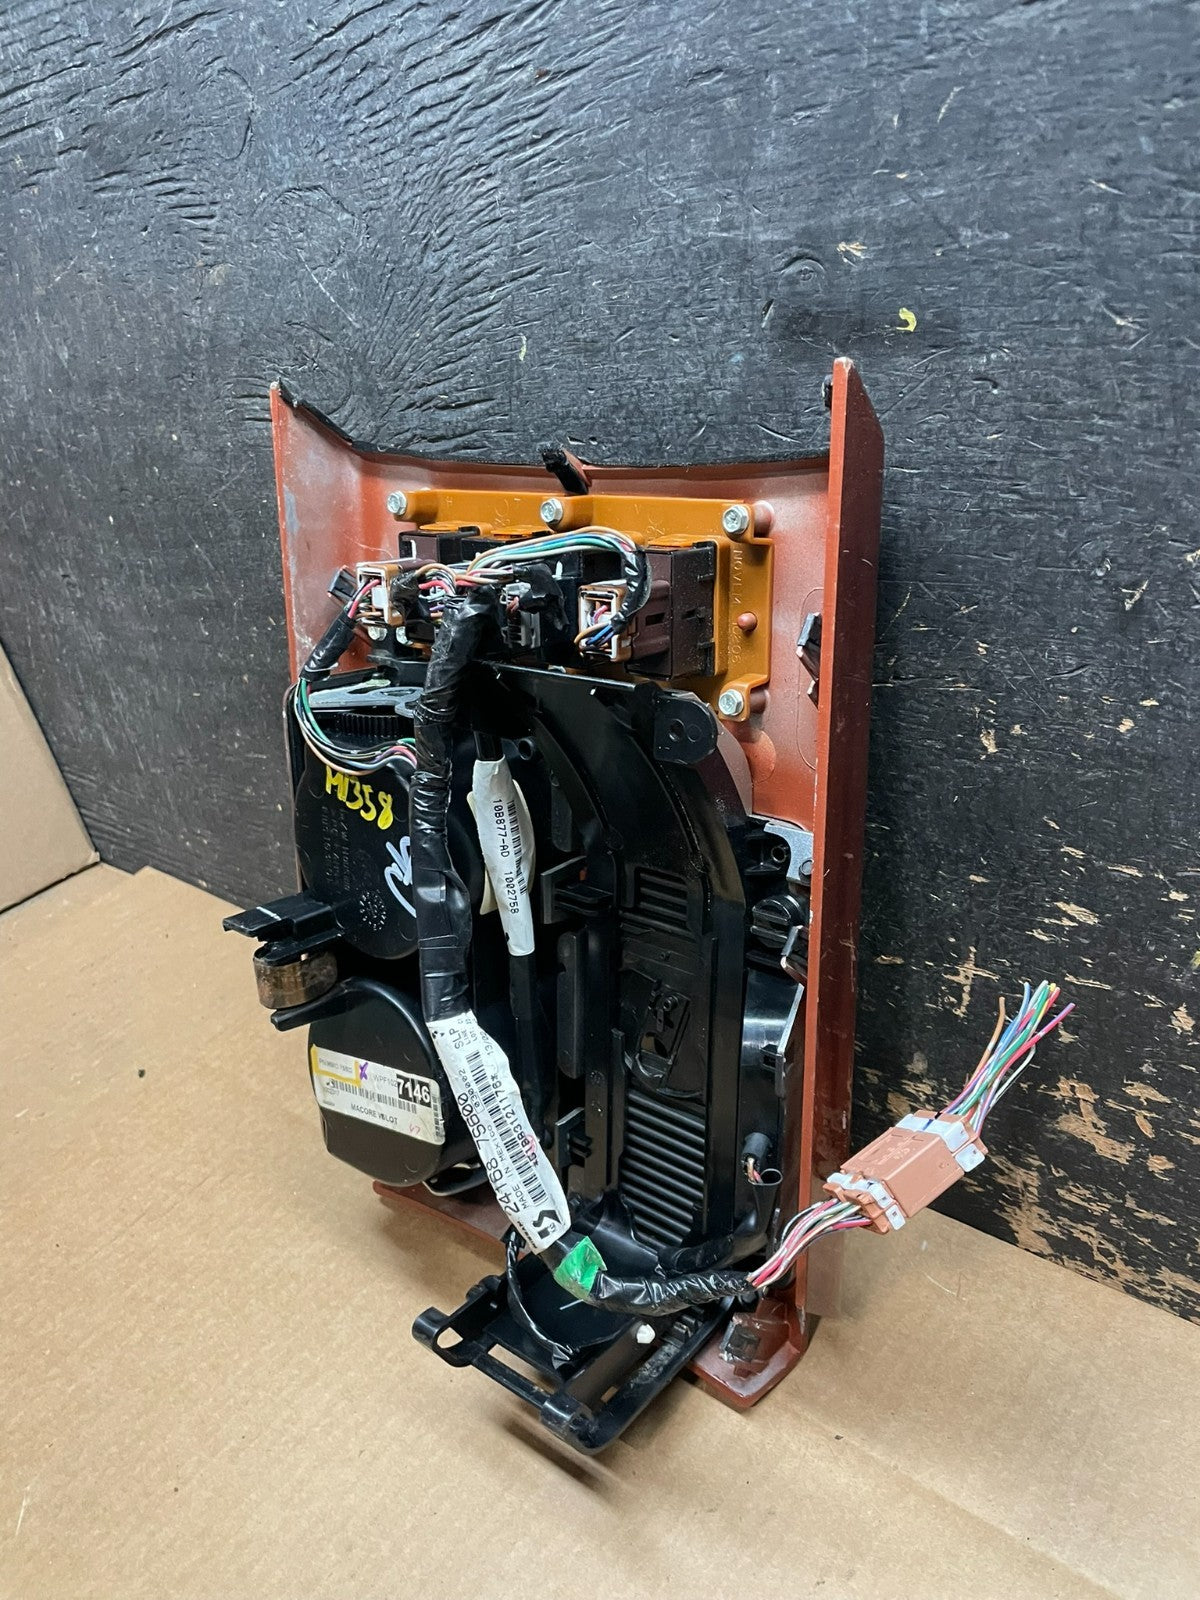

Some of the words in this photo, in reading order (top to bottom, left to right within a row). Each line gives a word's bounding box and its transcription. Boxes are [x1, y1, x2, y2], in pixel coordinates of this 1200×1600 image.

[493, 798, 510, 858] 10B877-AD
[503, 871, 519, 914] 1002758
[397, 1079, 430, 1103] 7146
[487, 1124, 505, 1162] MEXICO
[504, 1166, 513, 1178] IN
[512, 1184, 529, 1209] MADE
